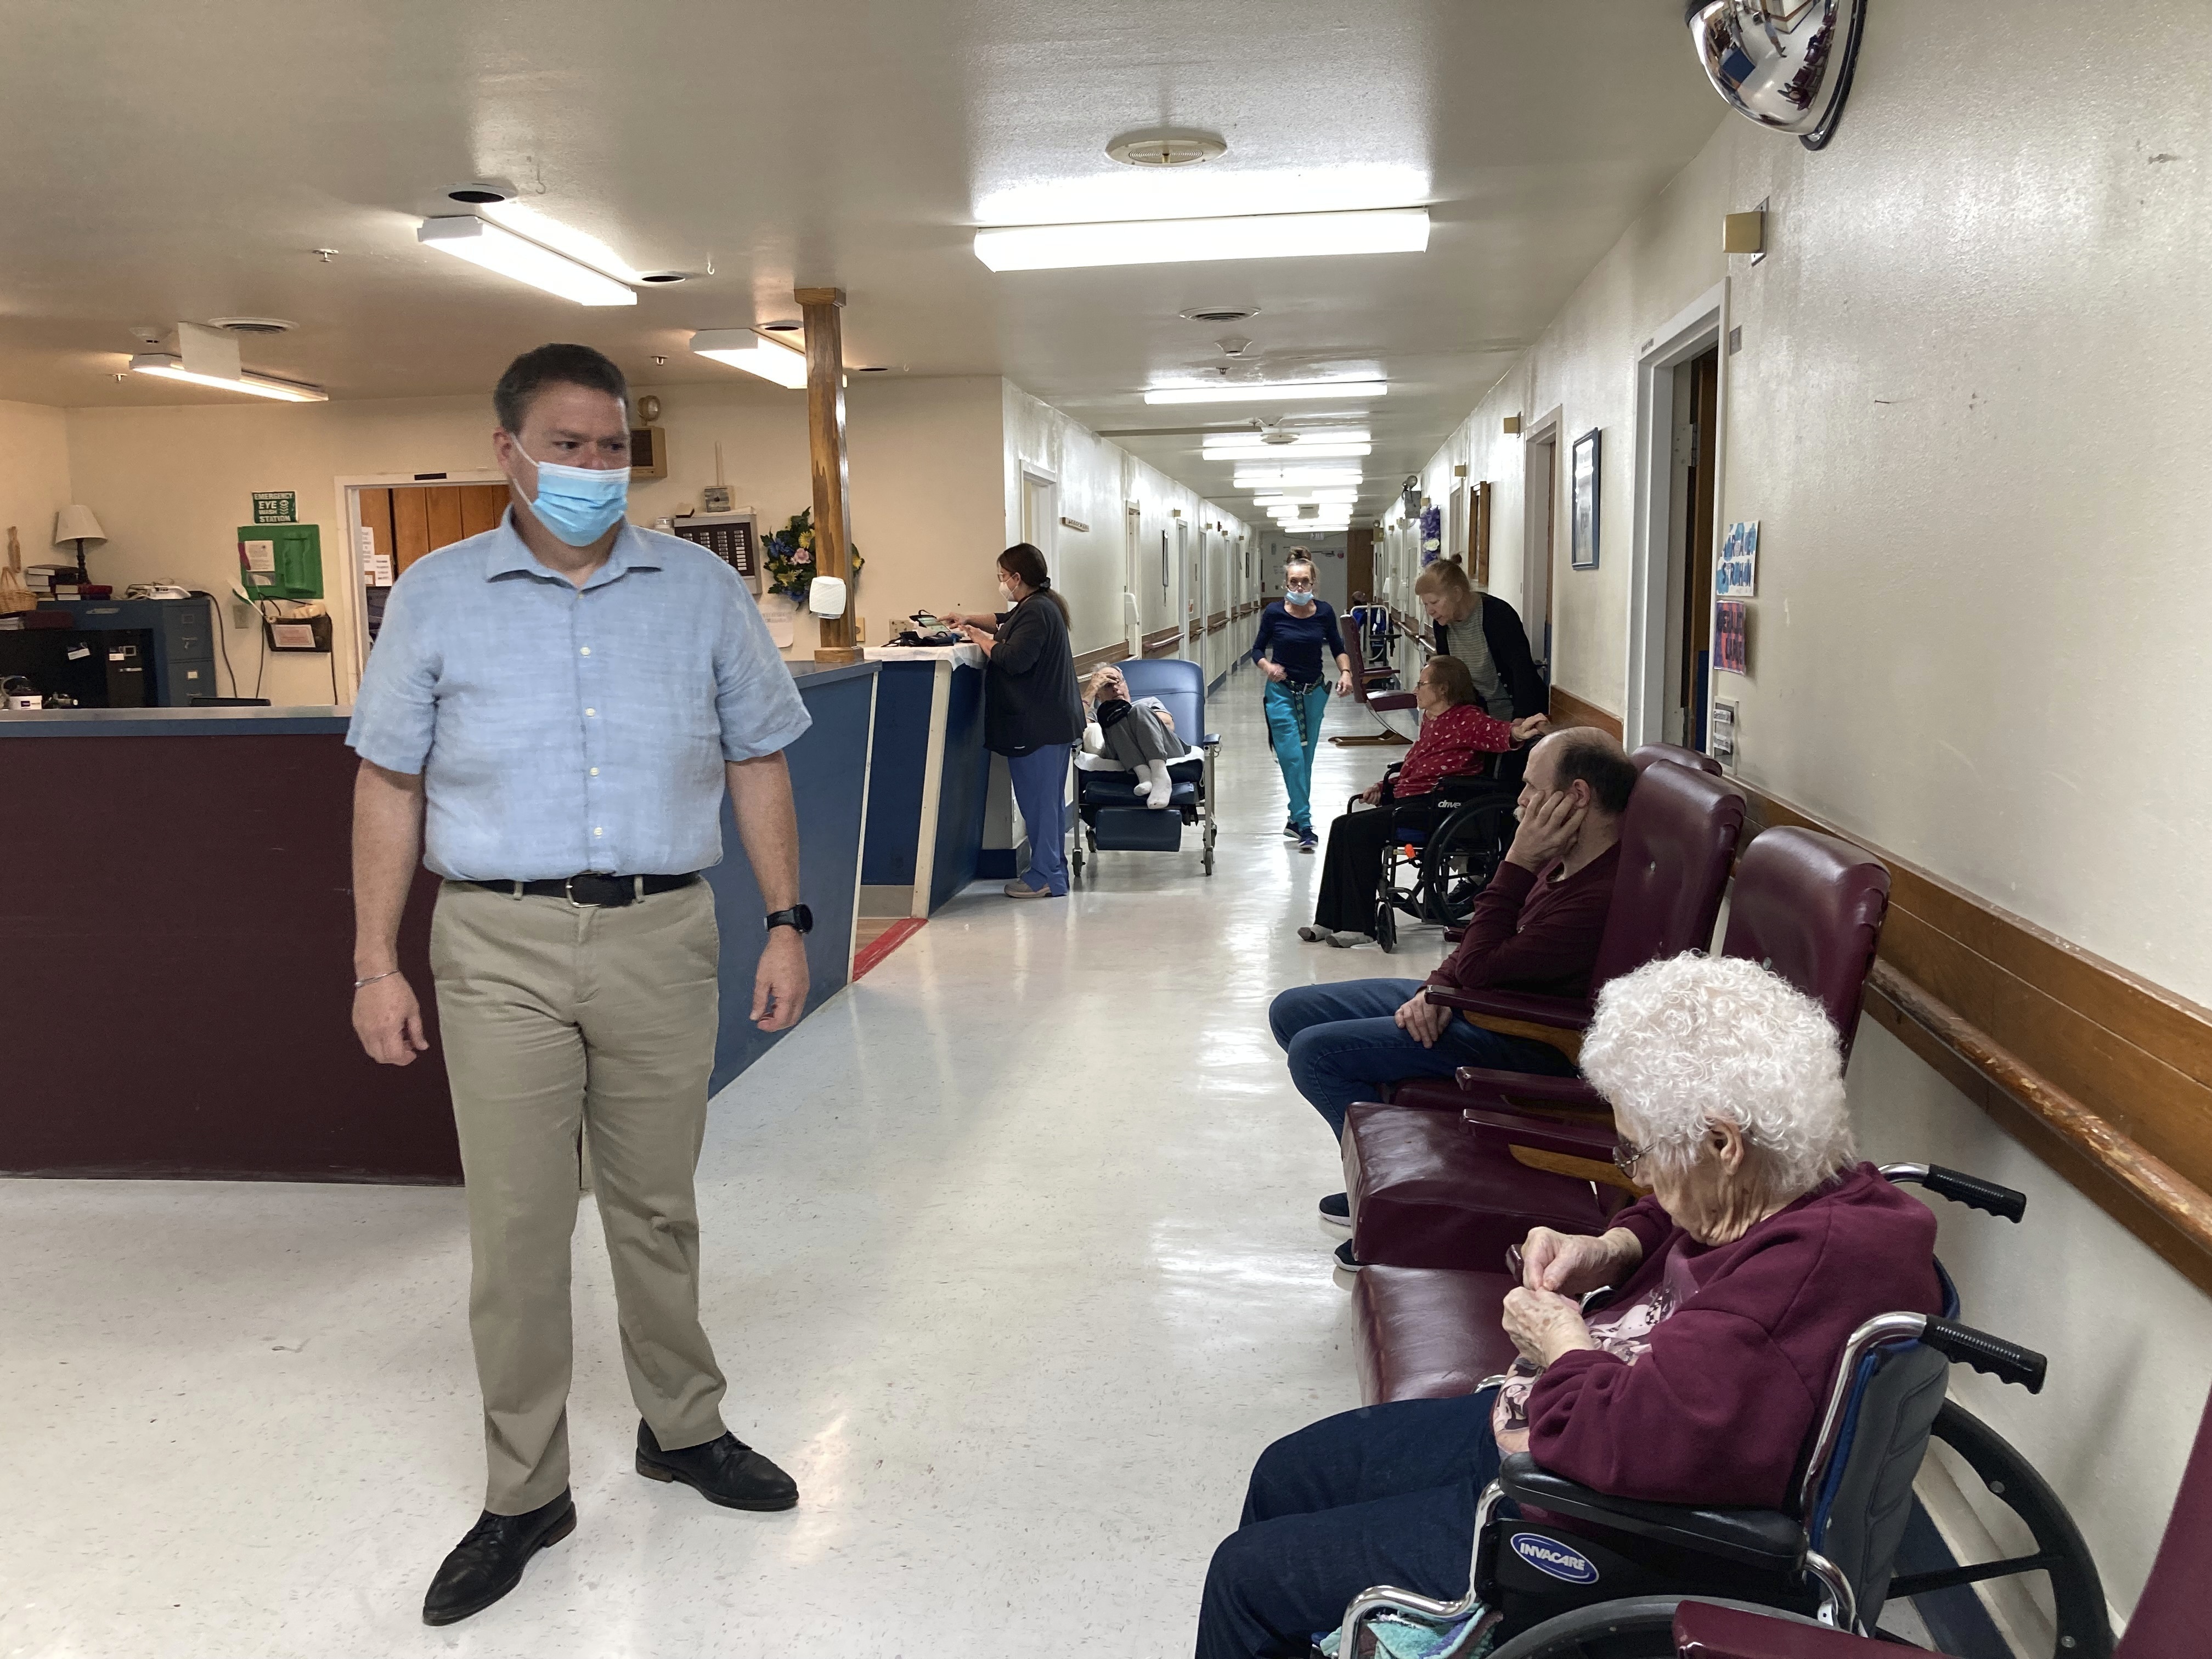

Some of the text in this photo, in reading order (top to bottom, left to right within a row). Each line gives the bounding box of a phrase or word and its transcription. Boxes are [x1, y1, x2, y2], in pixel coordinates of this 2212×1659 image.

[258, 500, 277, 509] EYE
[1437, 799, 1462, 809] drive
[1519, 1542, 1587, 1571] INVACARE
